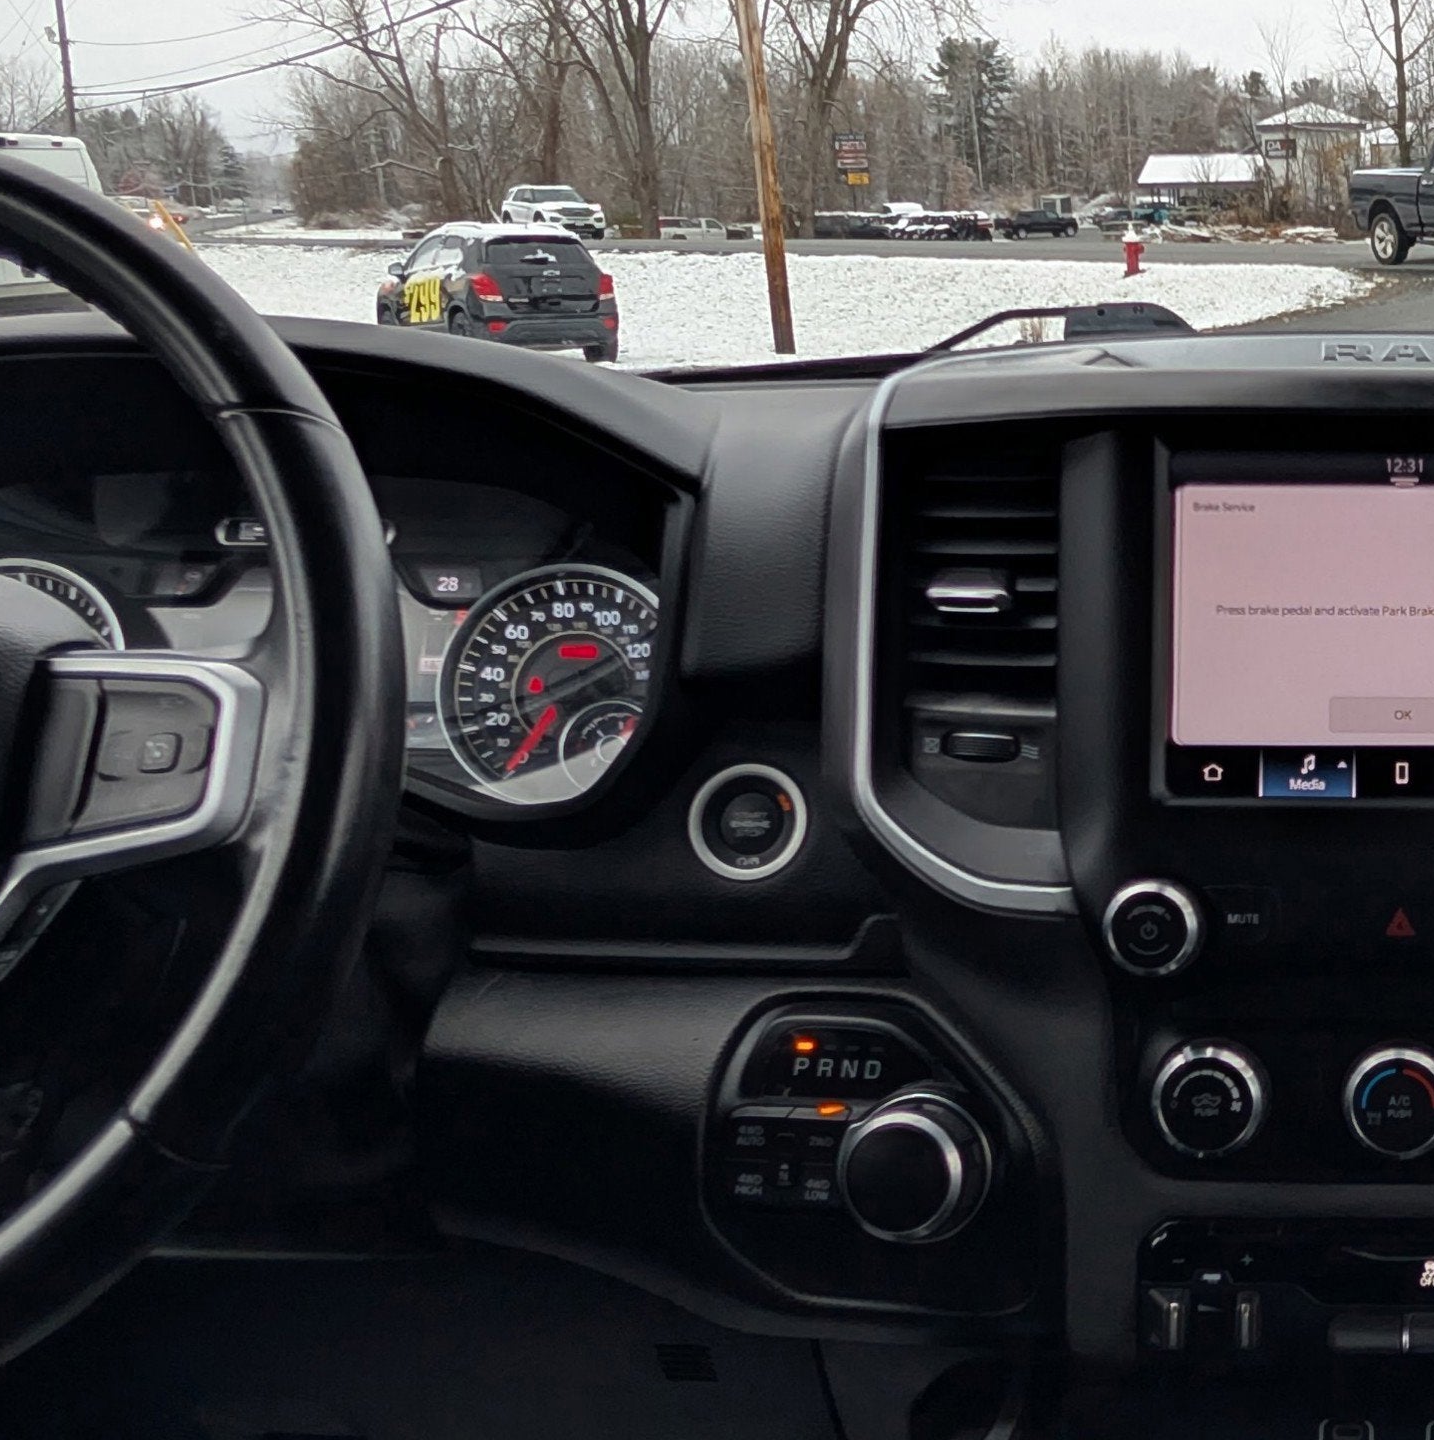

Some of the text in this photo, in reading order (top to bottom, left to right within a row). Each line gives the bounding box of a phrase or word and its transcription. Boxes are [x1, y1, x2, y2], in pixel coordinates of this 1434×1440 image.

[1386, 458, 1424, 473] 12:31
[437, 577, 460, 591] 28
[552, 603, 575, 618] 80
[1216, 605, 1246, 616] Press
[1248, 606, 1280, 616] brake
[1281, 606, 1313, 618] pedal
[1314, 606, 1336, 616] and
[1337, 606, 1380, 616] activate
[1382, 606, 1407, 616] Park
[593, 611, 621, 626] 100
[505, 625, 529, 639] 60
[626, 643, 651, 658] 120
[480, 667, 505, 681] 40
[486, 712, 510, 726] 20
[1394, 710, 1413, 720] OK
[1289, 778, 1326, 790] Media
[1226, 912, 1259, 924] MUTE
[793, 1057, 882, 1080] P R N D
